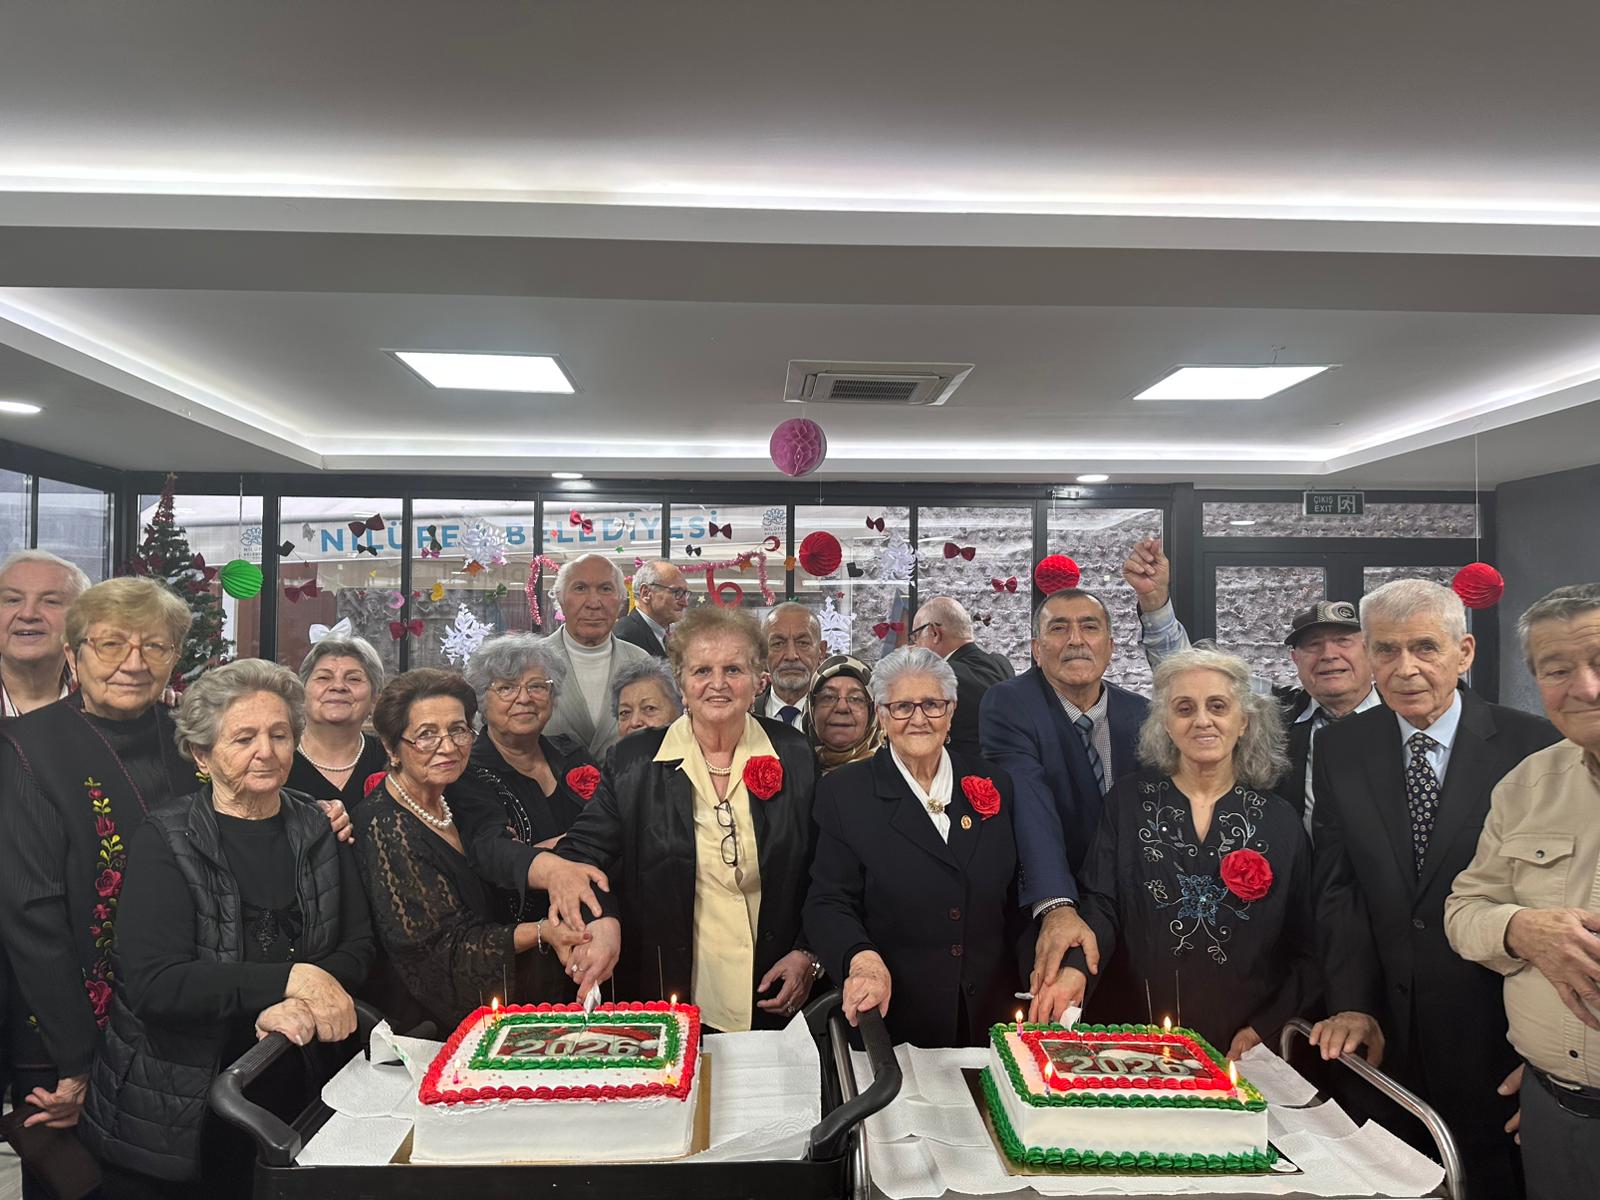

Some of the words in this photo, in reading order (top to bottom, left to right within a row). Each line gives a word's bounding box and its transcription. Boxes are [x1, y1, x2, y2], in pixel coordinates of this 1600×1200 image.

[1314, 504, 1333, 513] EXIT
[320, 521, 487, 552] NLÜFE
[510, 1037, 641, 1057] 2026
[1062, 1054, 1191, 1076] 2026
